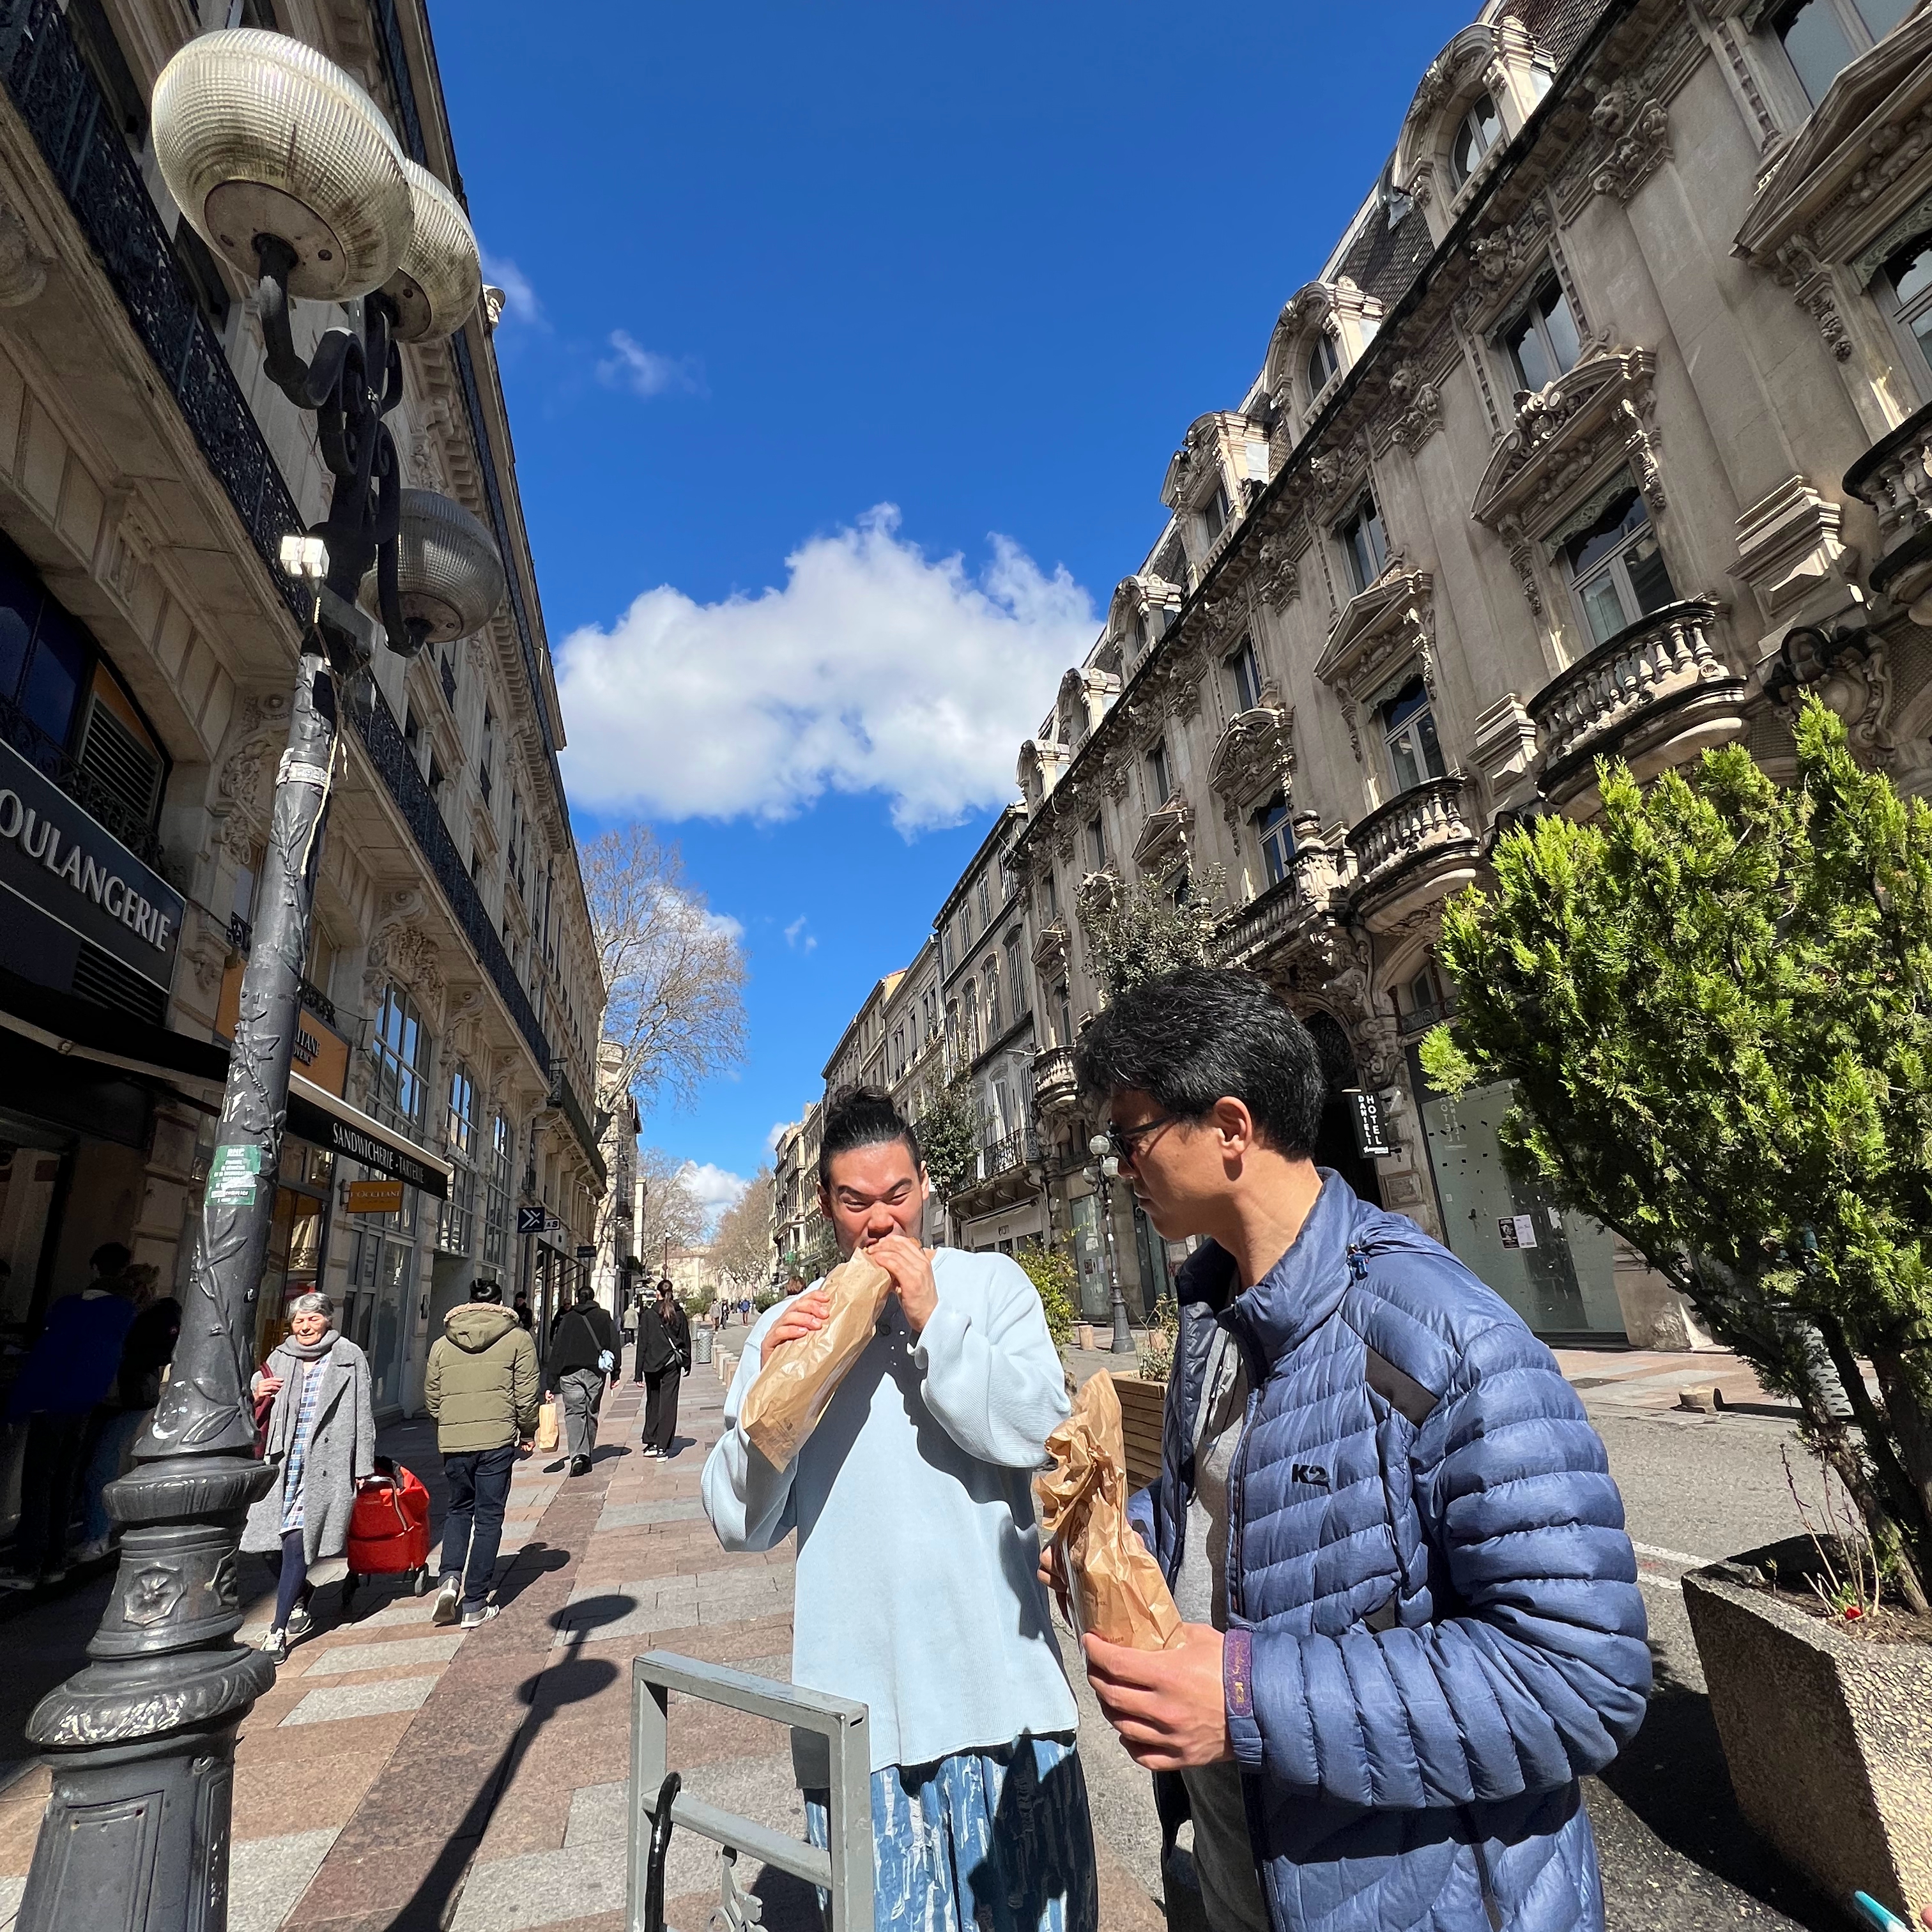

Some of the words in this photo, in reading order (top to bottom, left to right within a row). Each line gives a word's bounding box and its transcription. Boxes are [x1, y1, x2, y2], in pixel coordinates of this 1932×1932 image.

[0, 789, 171, 952] OULANGERIE
[1358, 1095, 1372, 1145] DANIELI
[1366, 1095, 1382, 1145] HOTEL
[333, 1123, 394, 1170] SANDWICHERIE
[1291, 1464, 1330, 1489] K2
